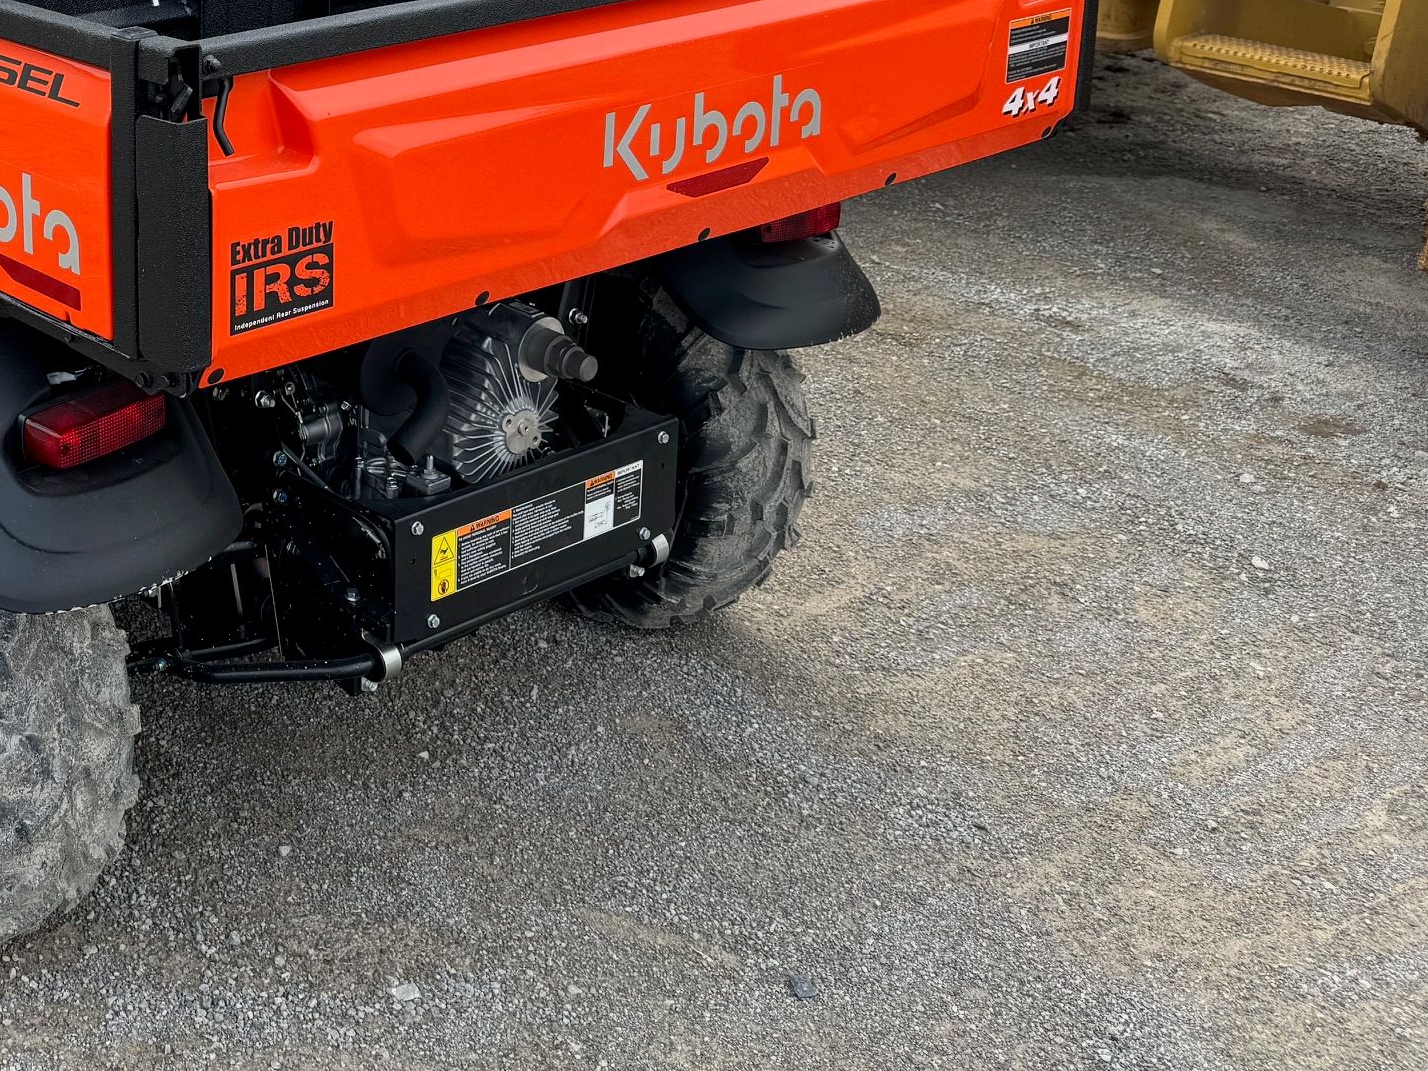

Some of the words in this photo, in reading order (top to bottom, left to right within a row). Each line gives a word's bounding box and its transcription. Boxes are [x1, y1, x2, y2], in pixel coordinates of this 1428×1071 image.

[1001, 75, 1062, 118] 4x4
[602, 74, 822, 181] Kubota
[230, 234, 283, 267] Extra
[287, 220, 334, 251] Duty
[235, 253, 331, 317] IRS
[234, 314, 275, 332] Independent
[276, 309, 292, 320] Rear
[292, 298, 329, 315] Suspension
[475, 514, 500, 529] WARNING
